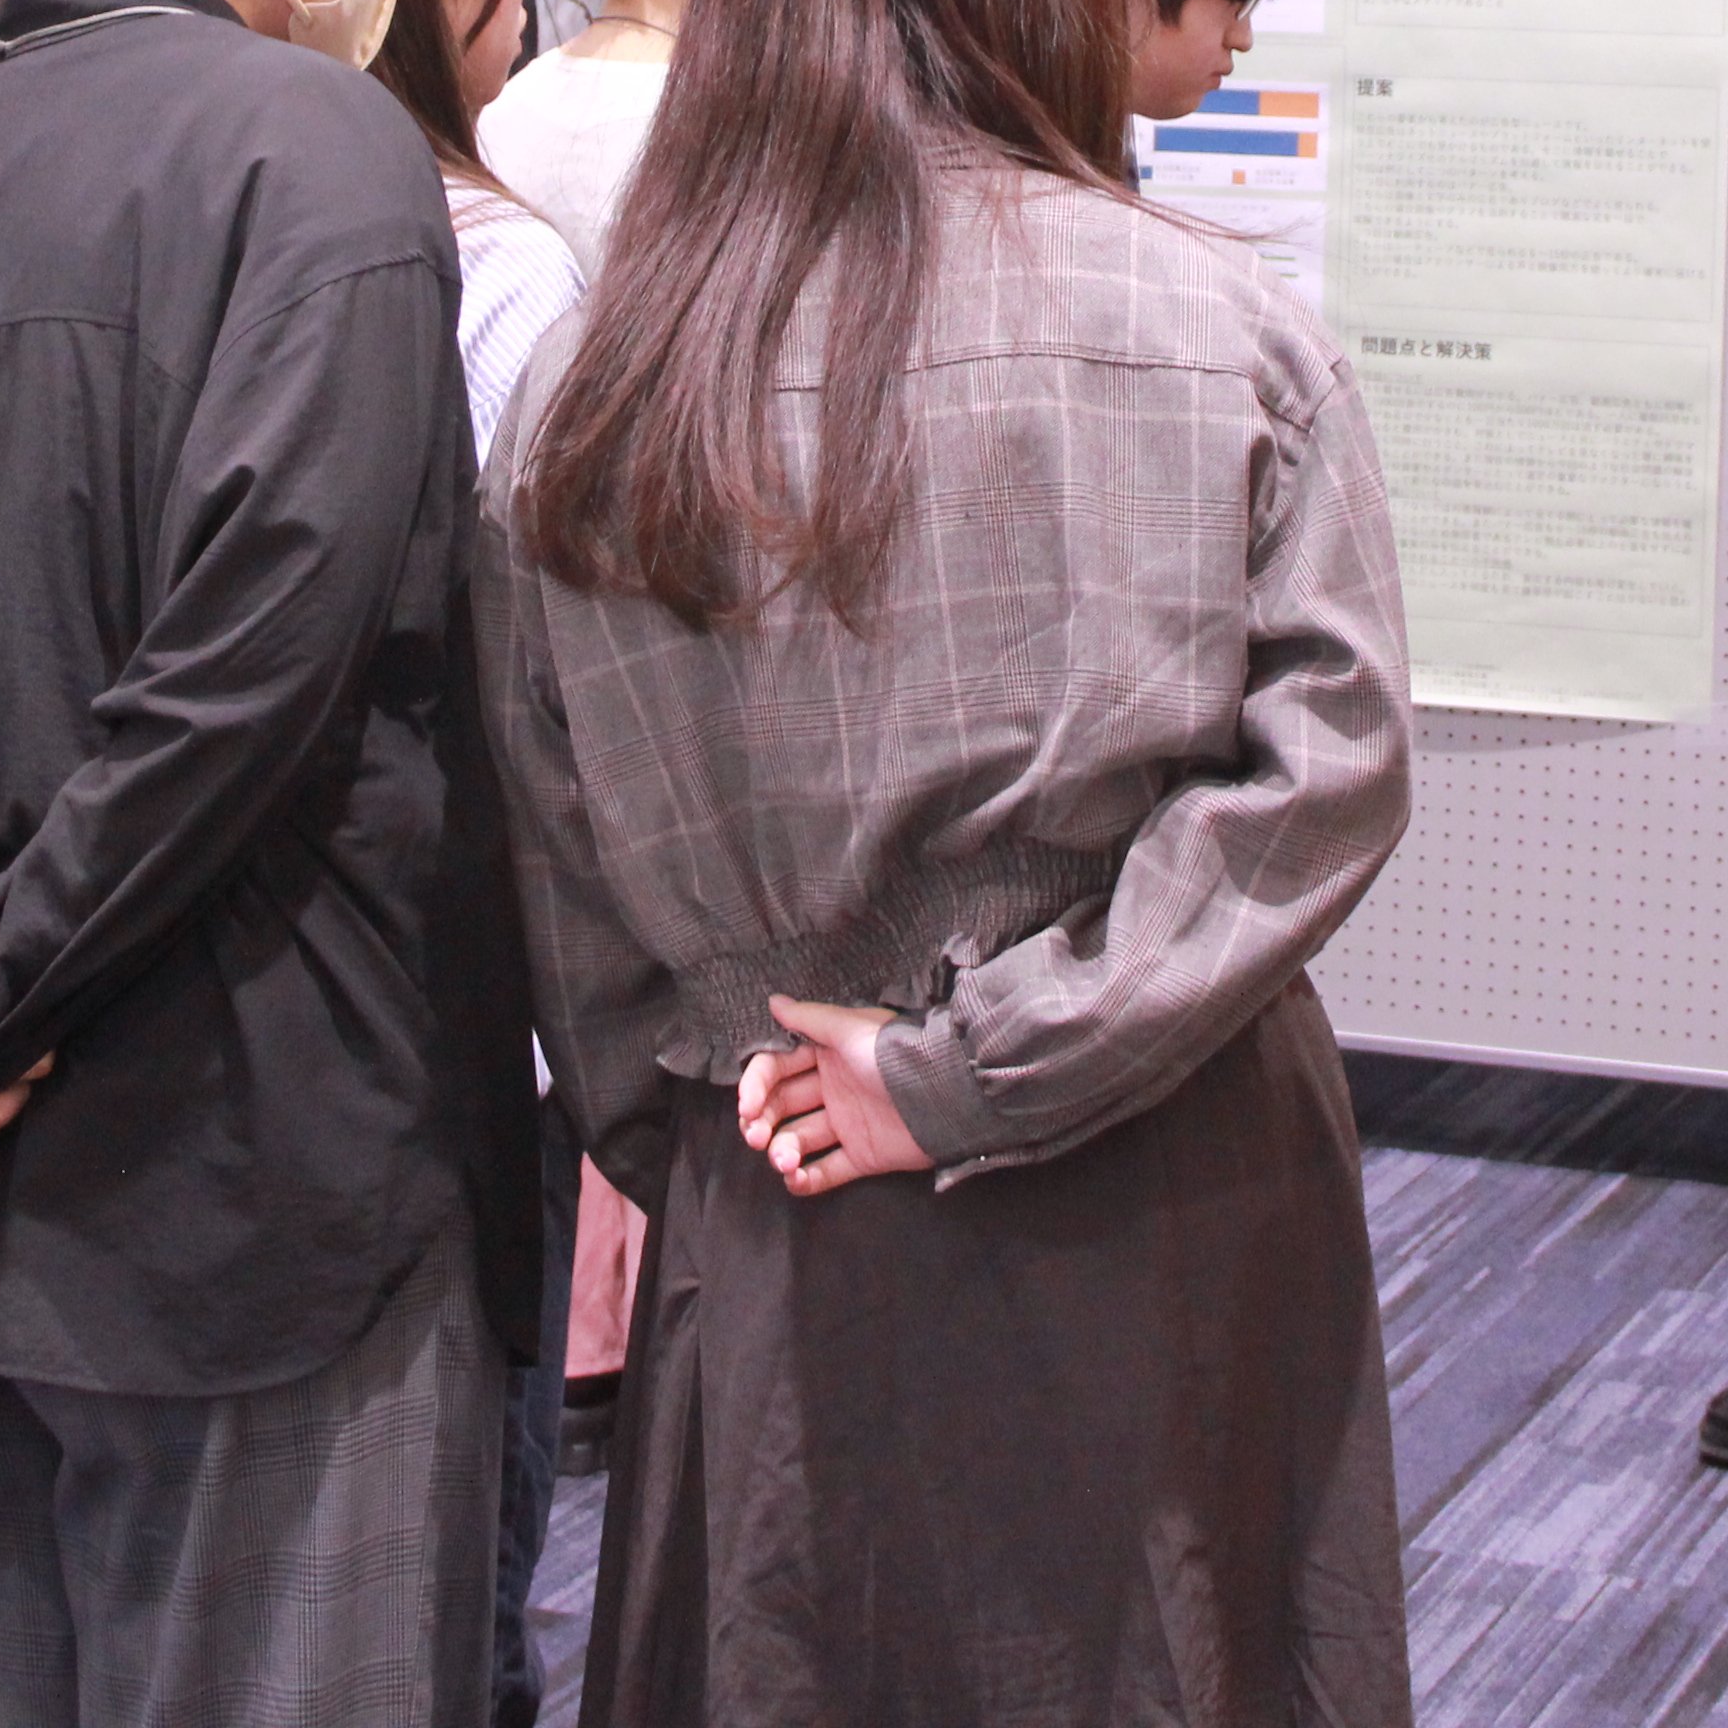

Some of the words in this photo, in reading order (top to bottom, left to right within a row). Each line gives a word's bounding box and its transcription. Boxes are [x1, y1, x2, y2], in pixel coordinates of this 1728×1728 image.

[1357, 78, 1394, 97] 提案
[1360, 335, 1493, 361] 問題点と解決策
